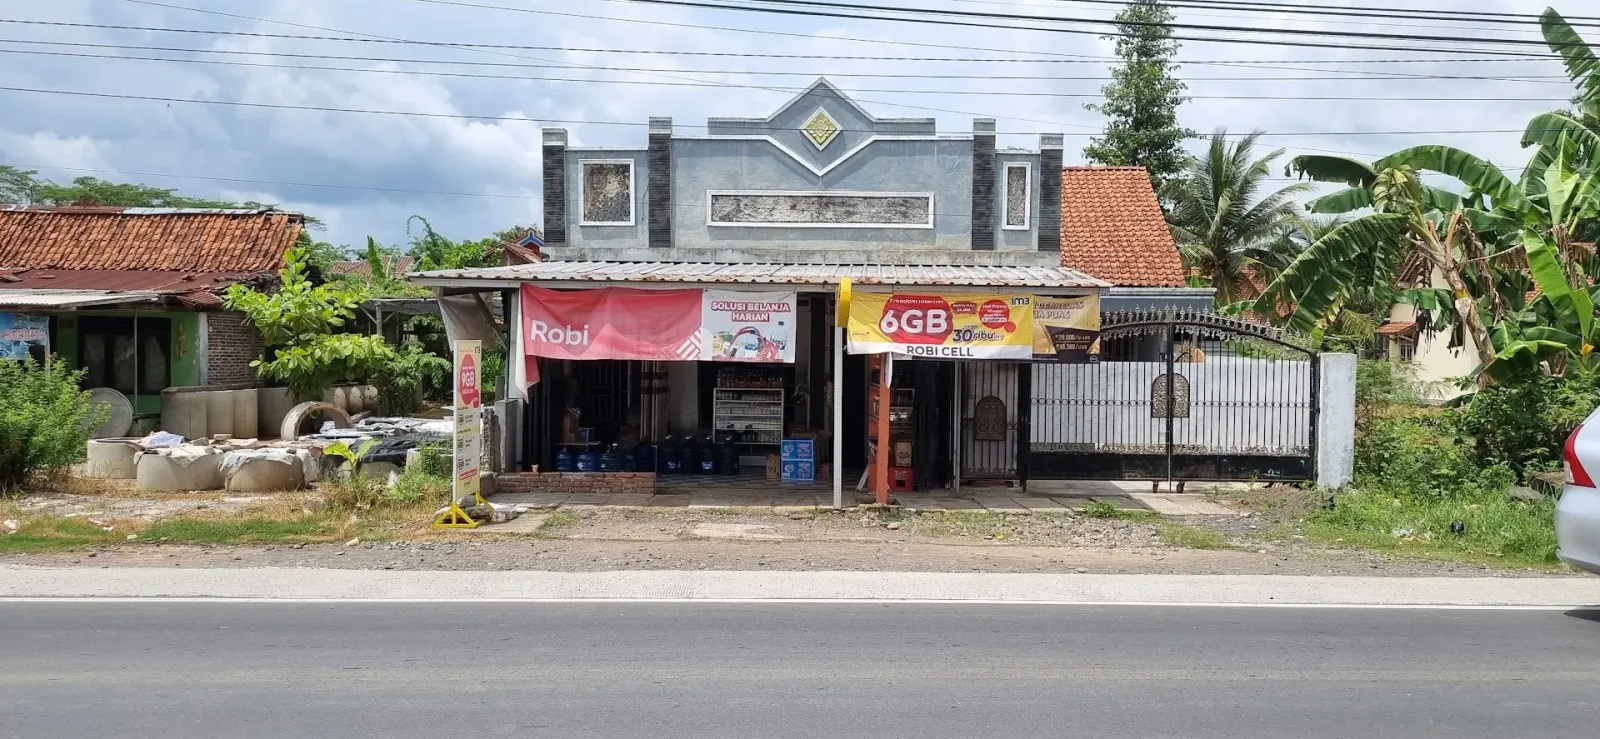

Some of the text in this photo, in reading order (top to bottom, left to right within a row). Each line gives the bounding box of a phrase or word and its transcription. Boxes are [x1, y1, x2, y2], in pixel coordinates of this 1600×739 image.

[711, 301, 791, 312] SOLUSI BELANJA
[731, 312, 770, 322] HARIAN
[1046, 310, 1071, 319] PUAS
[880, 308, 948, 334] 6GB
[531, 320, 589, 346] Robi
[907, 345, 974, 357] ROBI CELL
